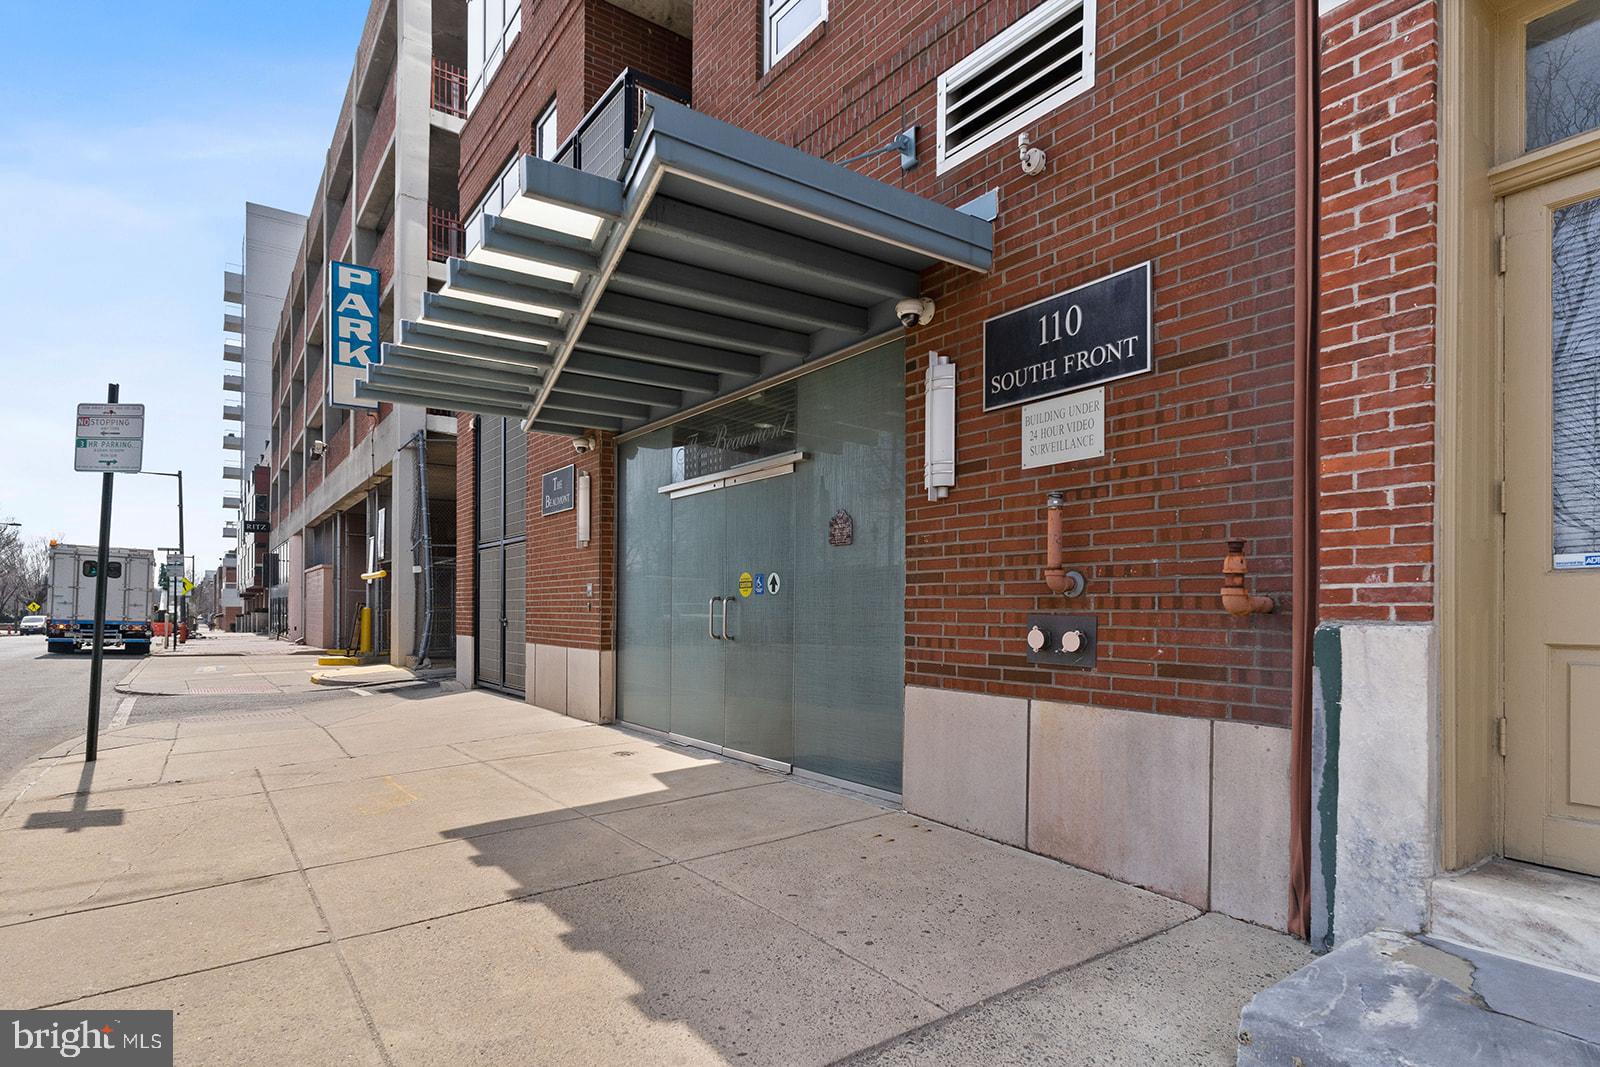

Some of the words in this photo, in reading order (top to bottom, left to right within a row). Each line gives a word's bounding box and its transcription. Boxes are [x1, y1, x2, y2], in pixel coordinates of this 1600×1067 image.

[337, 265, 374, 367] PARK
[1038, 304, 1083, 346] 110
[991, 358, 1057, 395] SOUTH
[1063, 335, 1139, 375] FRONT
[78, 417, 90, 426] NO
[90, 418, 130, 426] STOPPING
[1025, 407, 1066, 427] BUILDING
[1068, 400, 1100, 417] UNDER
[711, 412, 797, 452] Beaumont
[1030, 429, 1038, 442] 24
[1040, 424, 1065, 440] HOUR
[1066, 417, 1095, 433] VIDEO
[88, 440, 98, 448] HR
[101, 440, 134, 449] PARKING
[1029, 433, 1095, 457] SURVEILLANCE
[246, 522, 267, 531] RITZ
